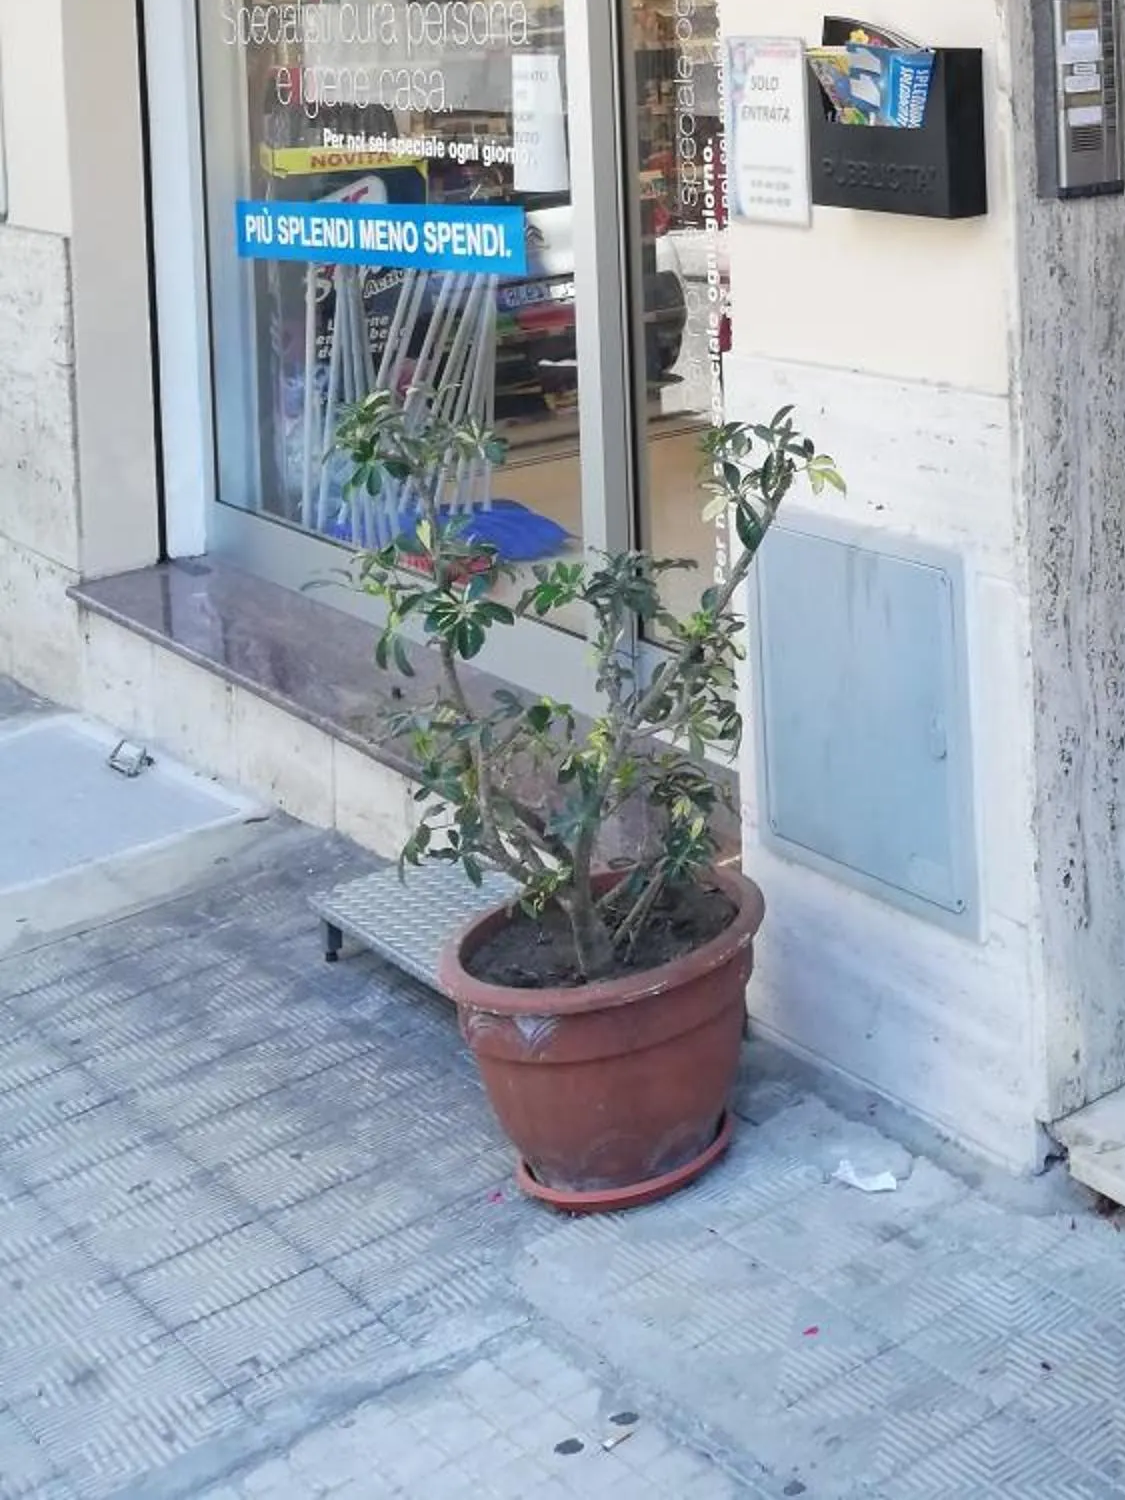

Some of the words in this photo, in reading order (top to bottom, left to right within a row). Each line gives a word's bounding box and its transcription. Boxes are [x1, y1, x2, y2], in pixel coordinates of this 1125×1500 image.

[339, 0, 398, 46] cura
[407, 0, 531, 57] persona
[276, 67, 293, 106] e
[672, 55, 700, 208] speciale
[741, 104, 791, 125] ENTRATA
[323, 127, 344, 149] Per
[347, 131, 366, 150] noi
[368, 130, 387, 151] sei
[390, 132, 445, 160] speciale
[449, 138, 480, 164] ogni
[702, 138, 719, 233] giorno.
[245, 207, 273, 245] PIÙ
[277, 215, 354, 249] SPLENDI
[359, 218, 418, 254] MENO
[424, 222, 513, 258] SPENDI.
[712, 536, 727, 587] Per
